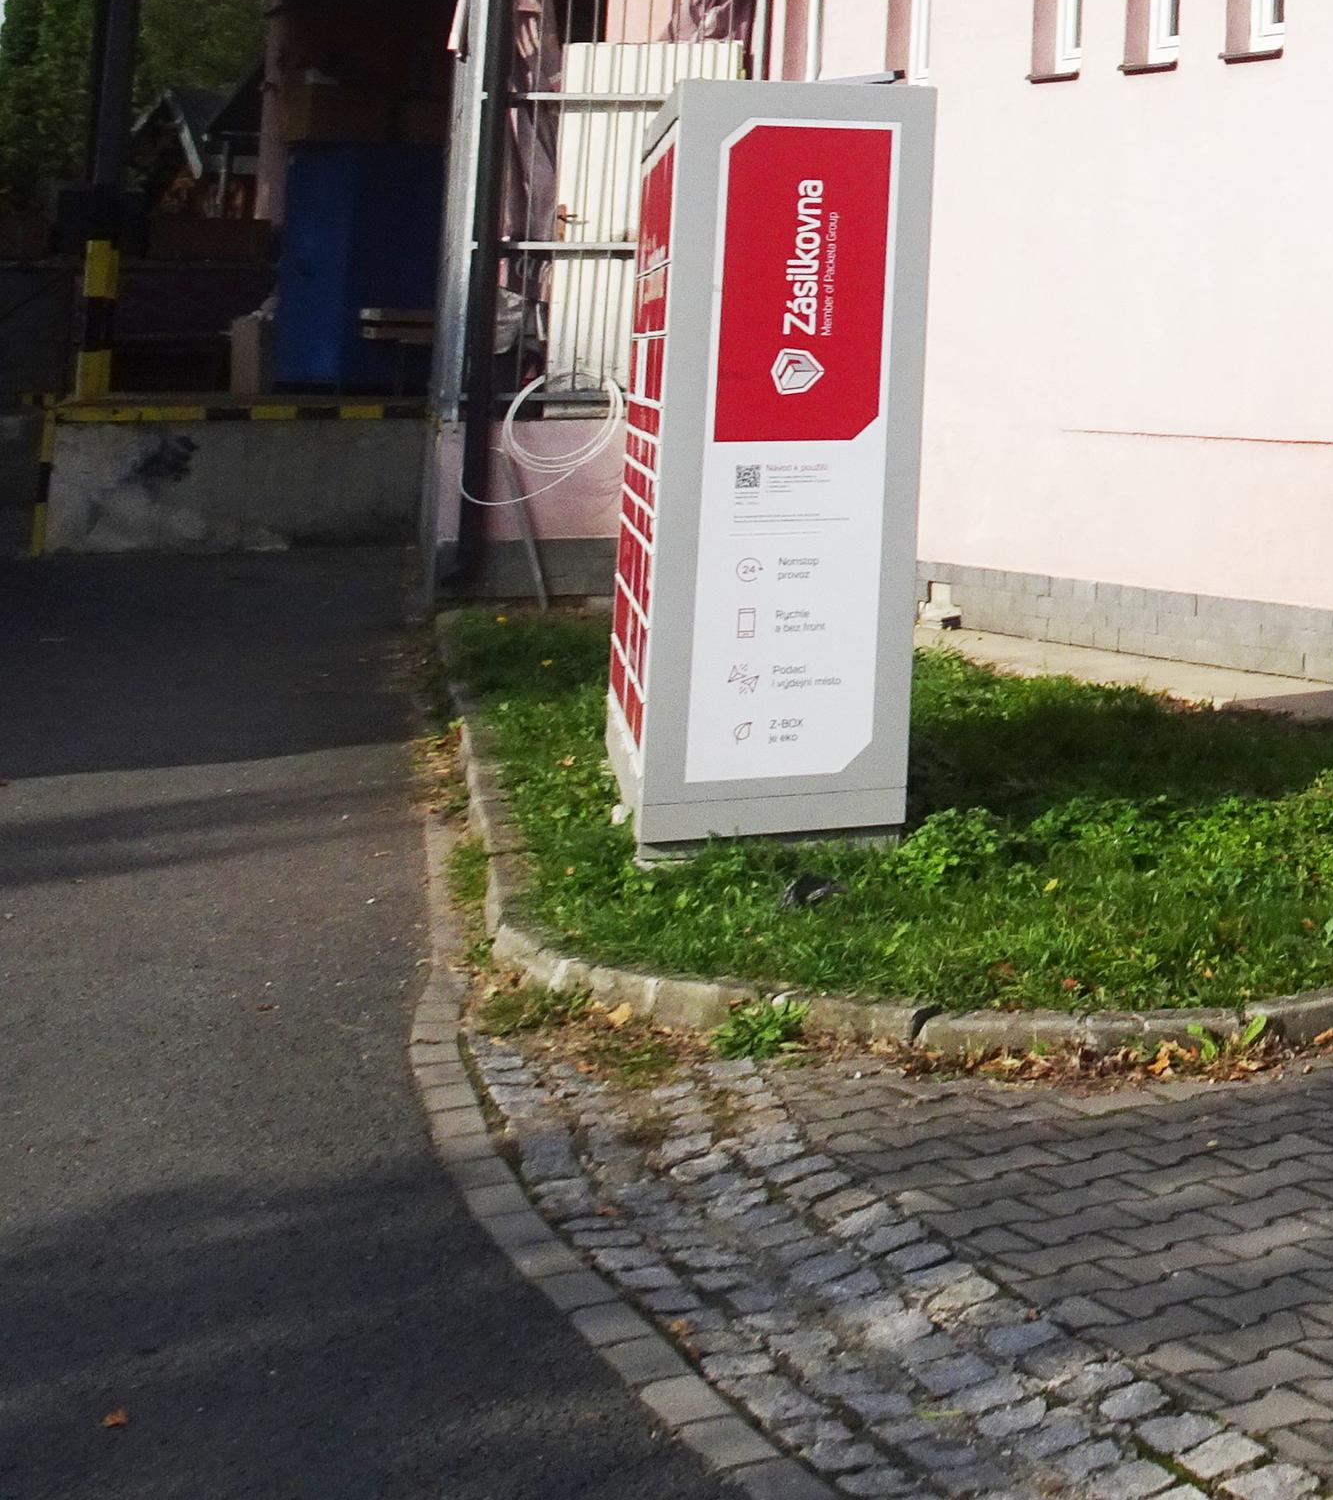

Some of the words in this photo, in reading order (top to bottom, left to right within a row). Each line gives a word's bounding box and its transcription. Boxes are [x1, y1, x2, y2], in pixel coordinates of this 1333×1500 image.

[825, 211, 840, 242] Group
[782, 179, 824, 336] Zásilkovna
[823, 243, 837, 282] Packeta
[824, 284, 835, 293] of
[820, 296, 834, 336] Member
[741, 565, 756, 574] 24
[778, 556, 819, 566] Nonstop
